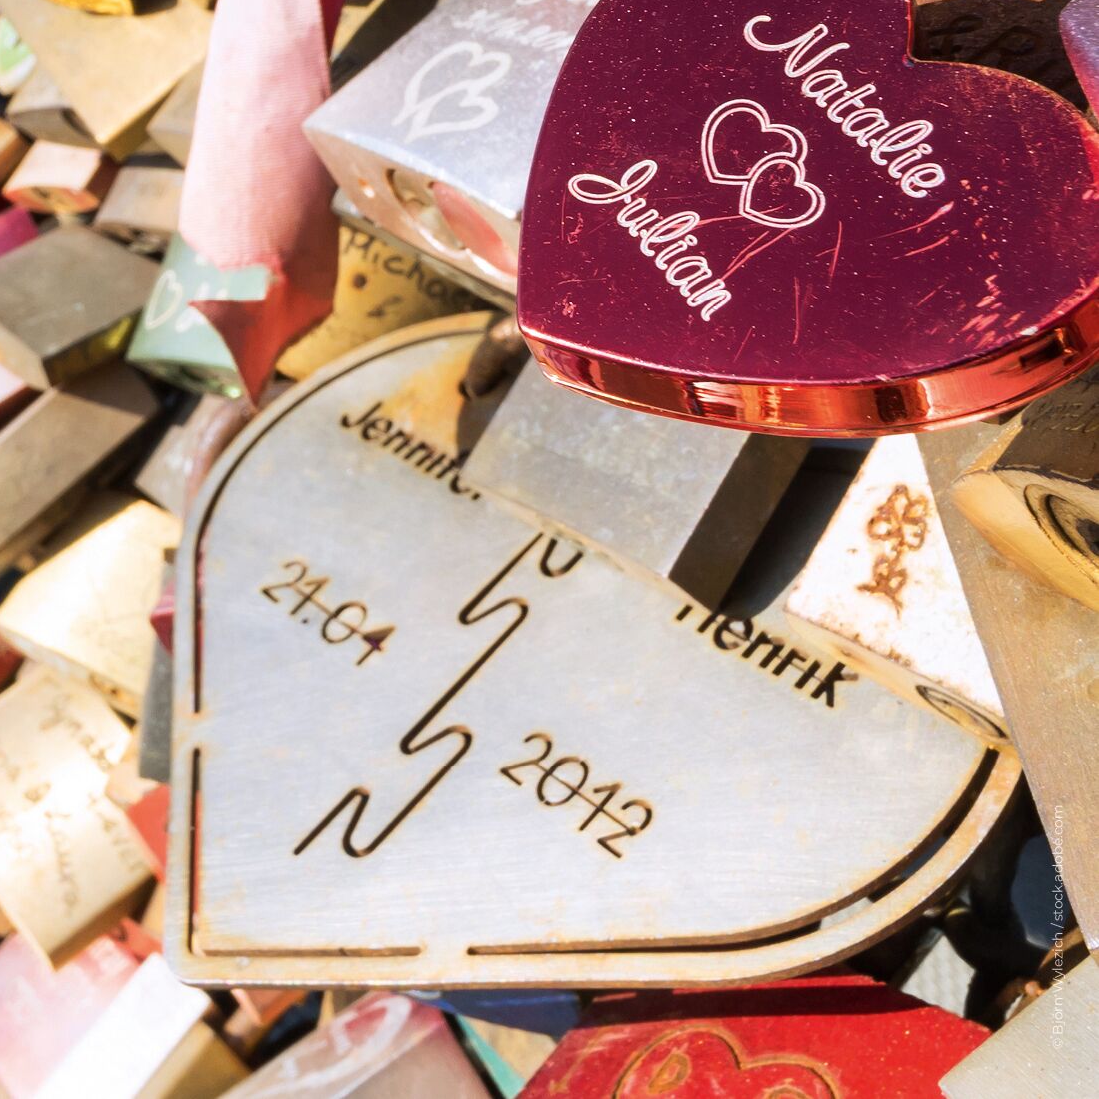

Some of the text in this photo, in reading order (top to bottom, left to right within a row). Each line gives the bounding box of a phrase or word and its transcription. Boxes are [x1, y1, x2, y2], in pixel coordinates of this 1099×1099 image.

[744, 14, 946, 199] Natalie
[568, 159, 733, 322] Julian
[499, 732, 654, 860] 2012
